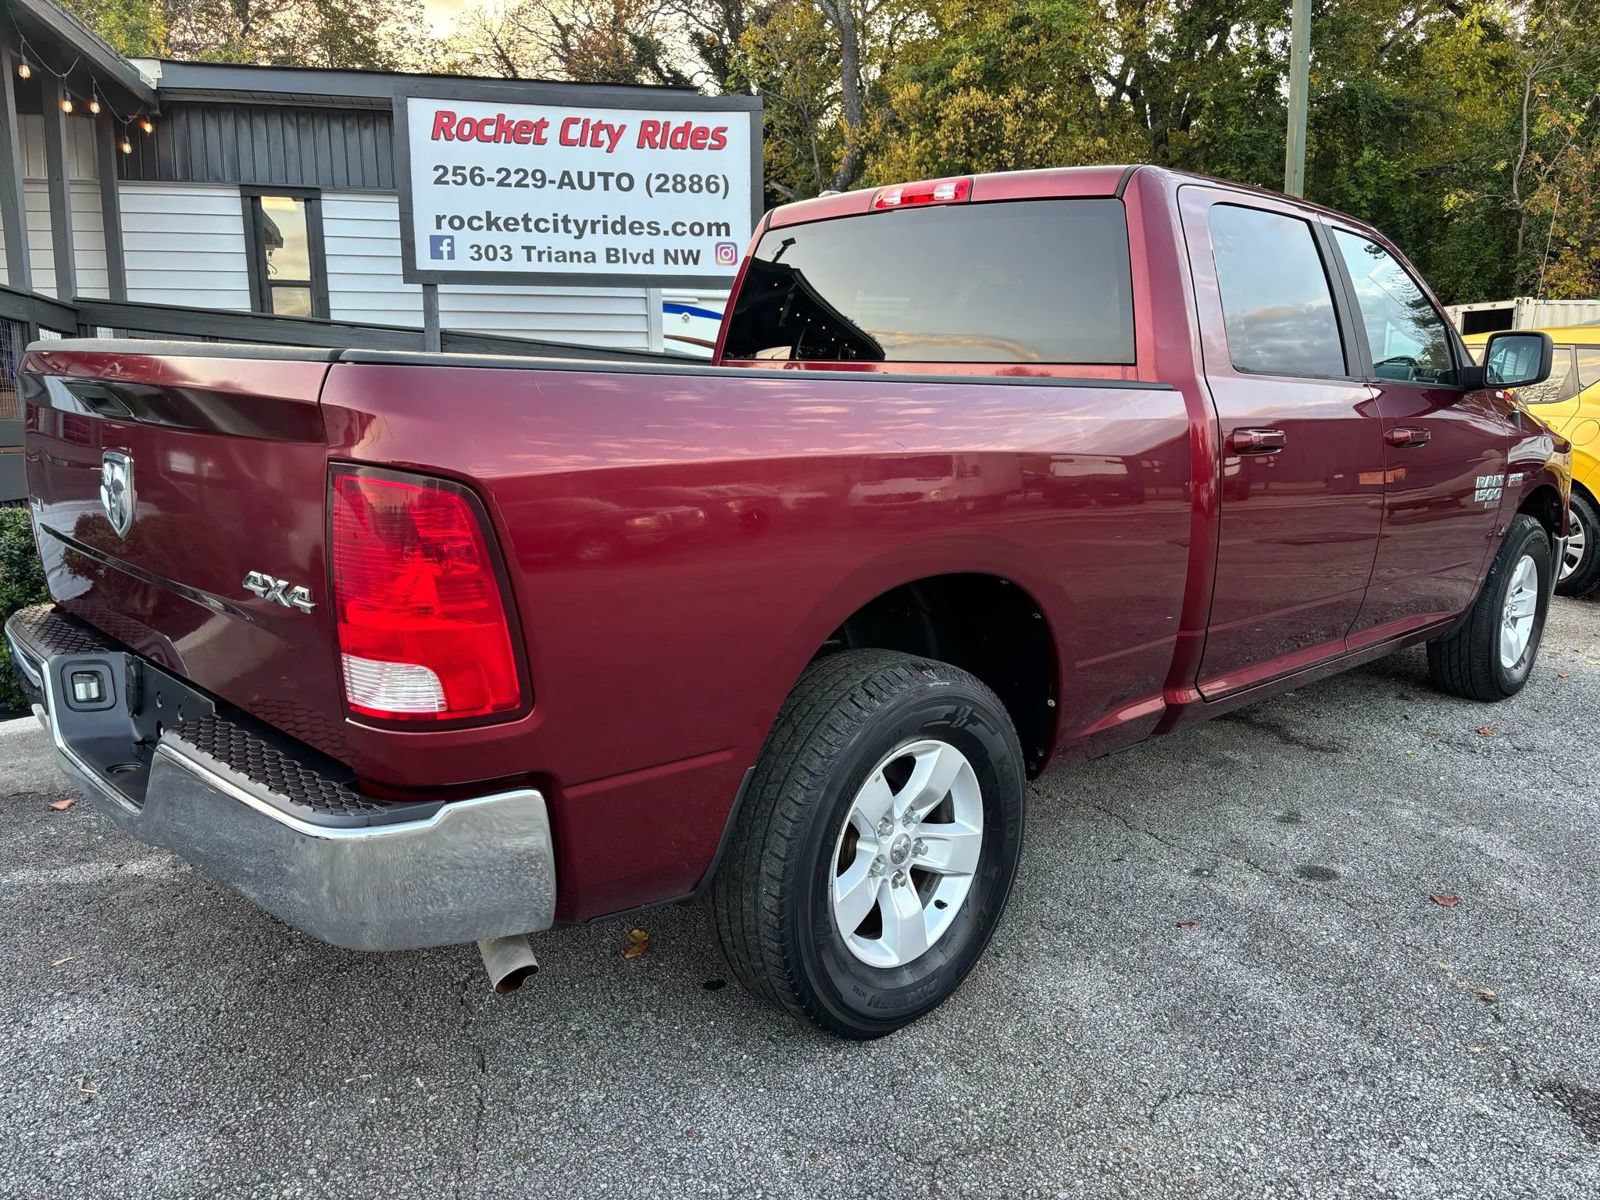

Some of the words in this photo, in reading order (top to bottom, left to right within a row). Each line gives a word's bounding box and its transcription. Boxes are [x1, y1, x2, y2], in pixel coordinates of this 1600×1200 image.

[431, 110, 549, 145] Rocket
[559, 116, 626, 153] City
[636, 119, 729, 151] Rides
[432, 165, 635, 192] 256-229-AUTO
[645, 173, 730, 199] (2886)
[435, 211, 731, 240] rocketcityrides.com
[469, 244, 513, 262] 303
[521, 246, 597, 264] Triana
[605, 247, 655, 265] Blvd
[664, 249, 702, 266] NW
[1474, 487, 1503, 502] 1500
